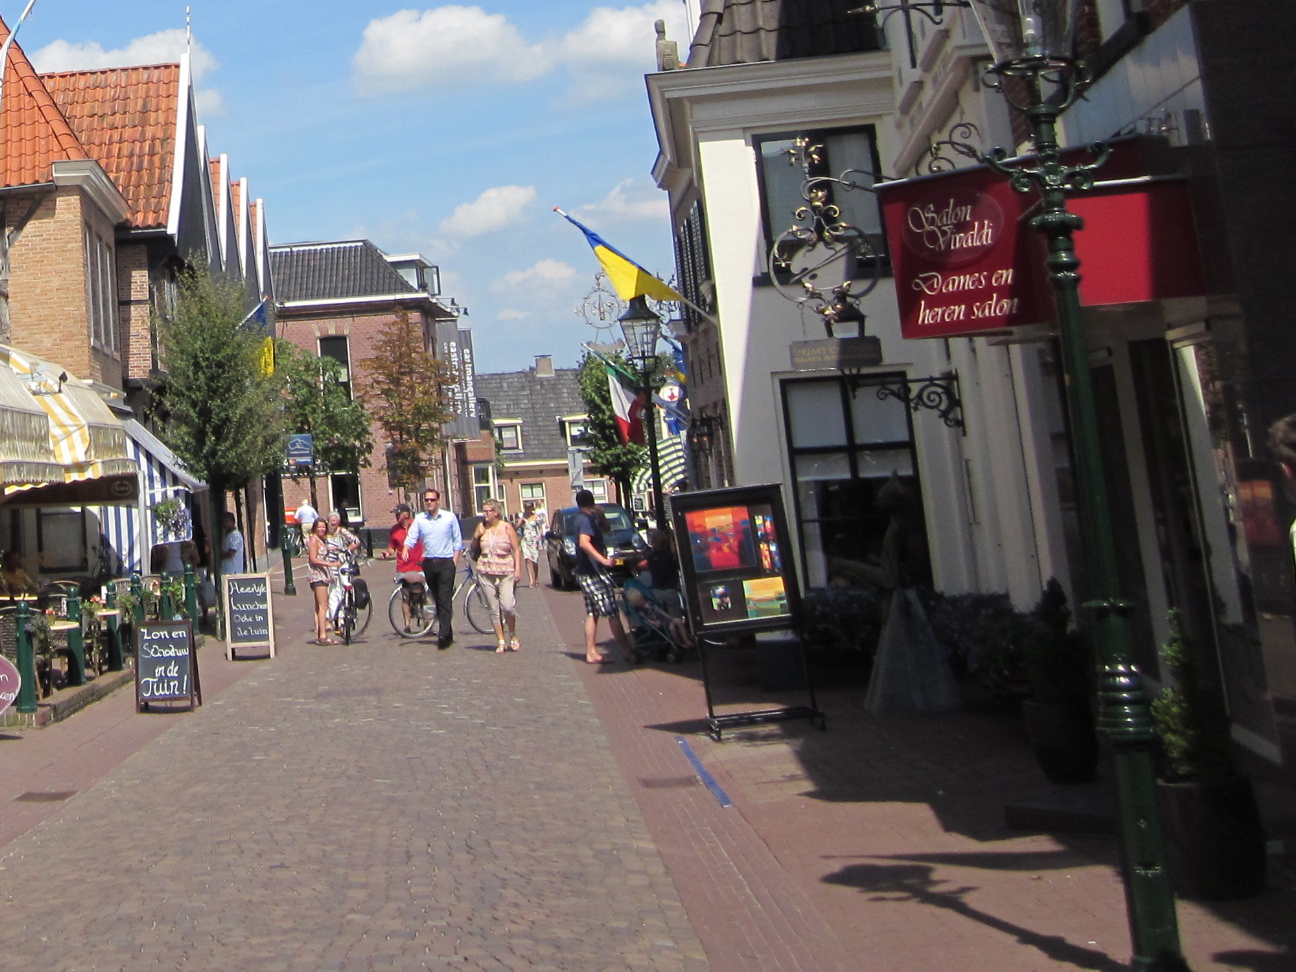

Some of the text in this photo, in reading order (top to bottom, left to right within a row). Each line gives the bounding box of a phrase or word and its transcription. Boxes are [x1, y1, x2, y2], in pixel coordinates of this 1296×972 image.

[908, 198, 971, 232] Salon
[924, 220, 993, 250] Vivaldi
[912, 268, 1013, 295] Dames en
[918, 293, 1018, 325] heren salon
[140, 628, 186, 640] Zon en
[154, 660, 179, 678] in de
